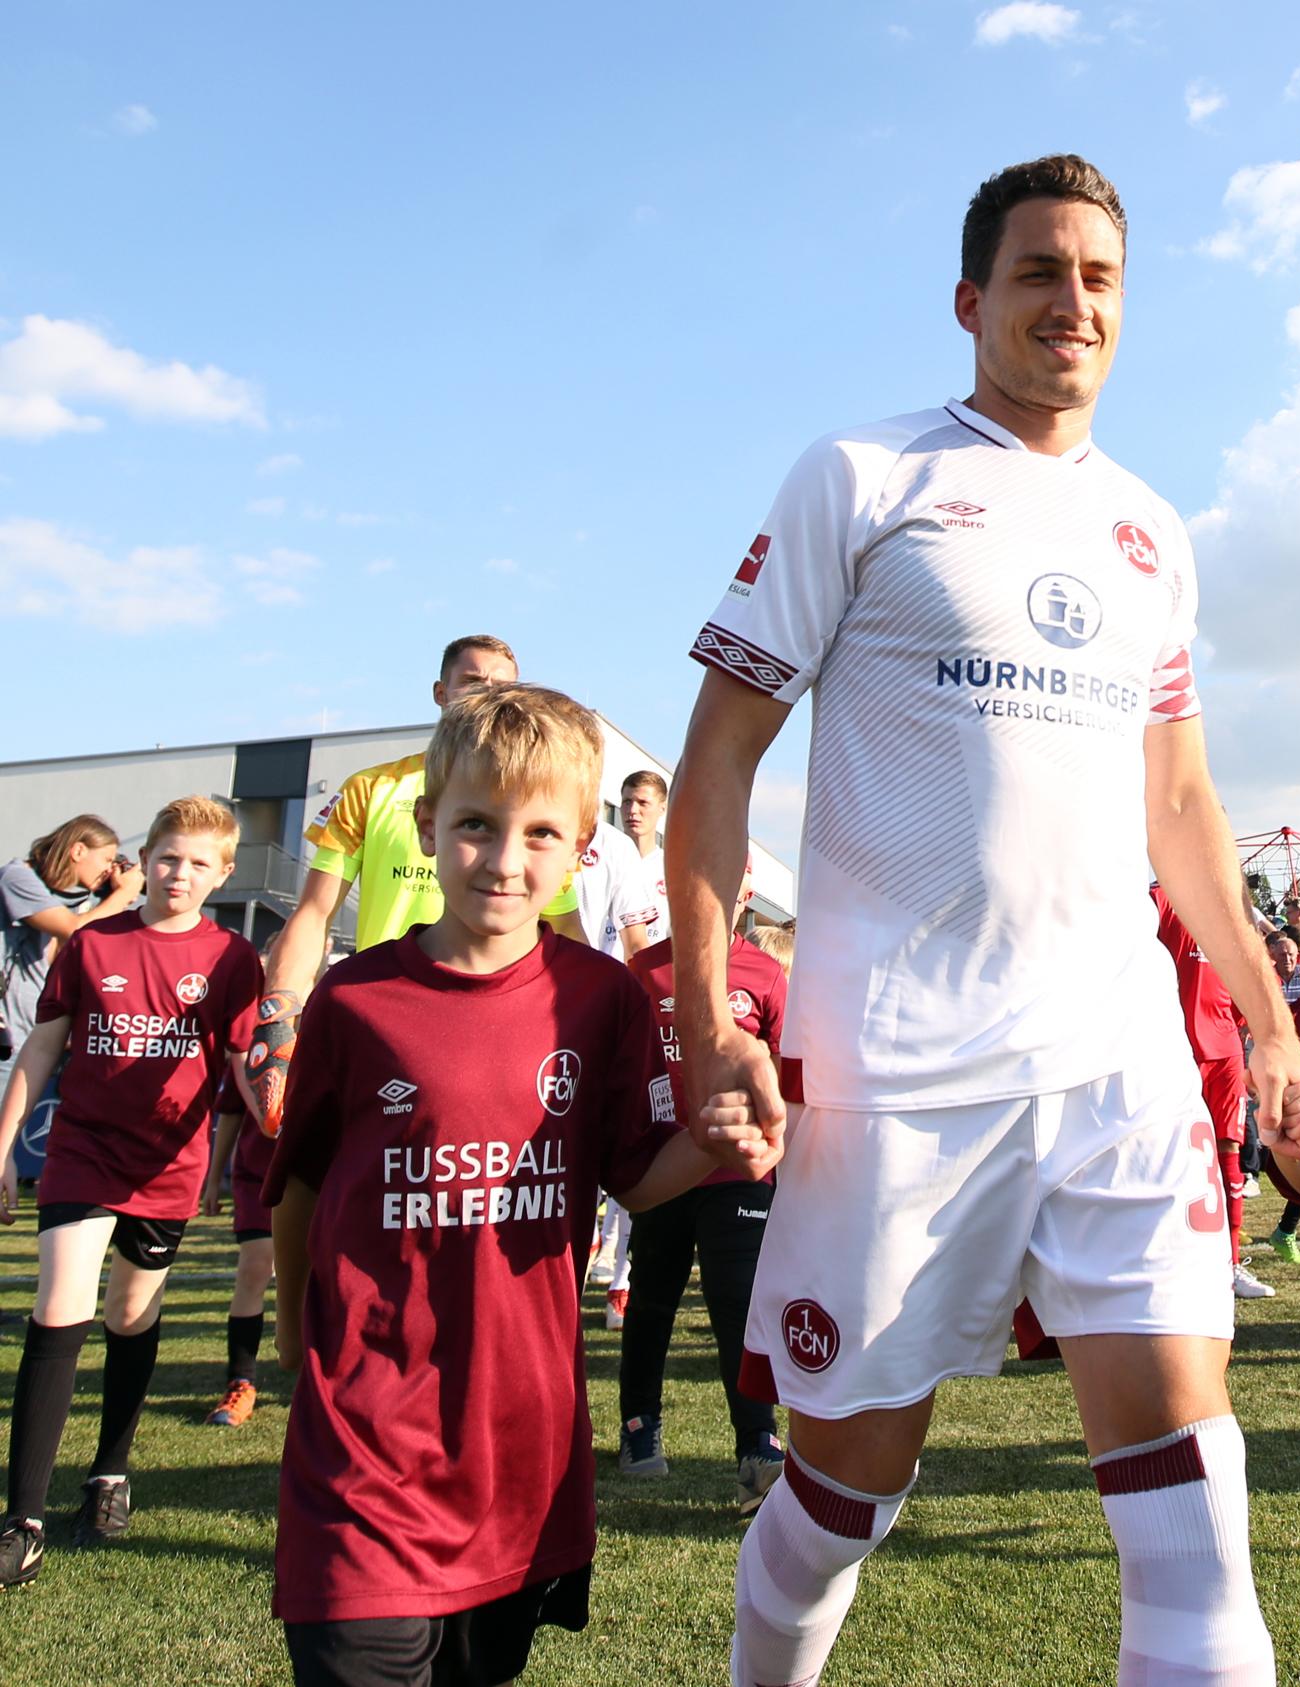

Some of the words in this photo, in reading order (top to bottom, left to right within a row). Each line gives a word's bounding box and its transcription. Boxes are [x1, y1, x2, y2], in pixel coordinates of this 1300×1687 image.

[942, 518, 985, 529] umbro
[88, 1013, 200, 1037] FUSSBALL
[86, 1036, 200, 1059] ERLEBNIS
[543, 1075, 578, 1101] FCN
[383, 1103, 413, 1116] umbro
[384, 1138, 567, 1184] FUSSBALL
[382, 1182, 566, 1230] ERLEBNIS
[788, 1325, 828, 1359] FCN
